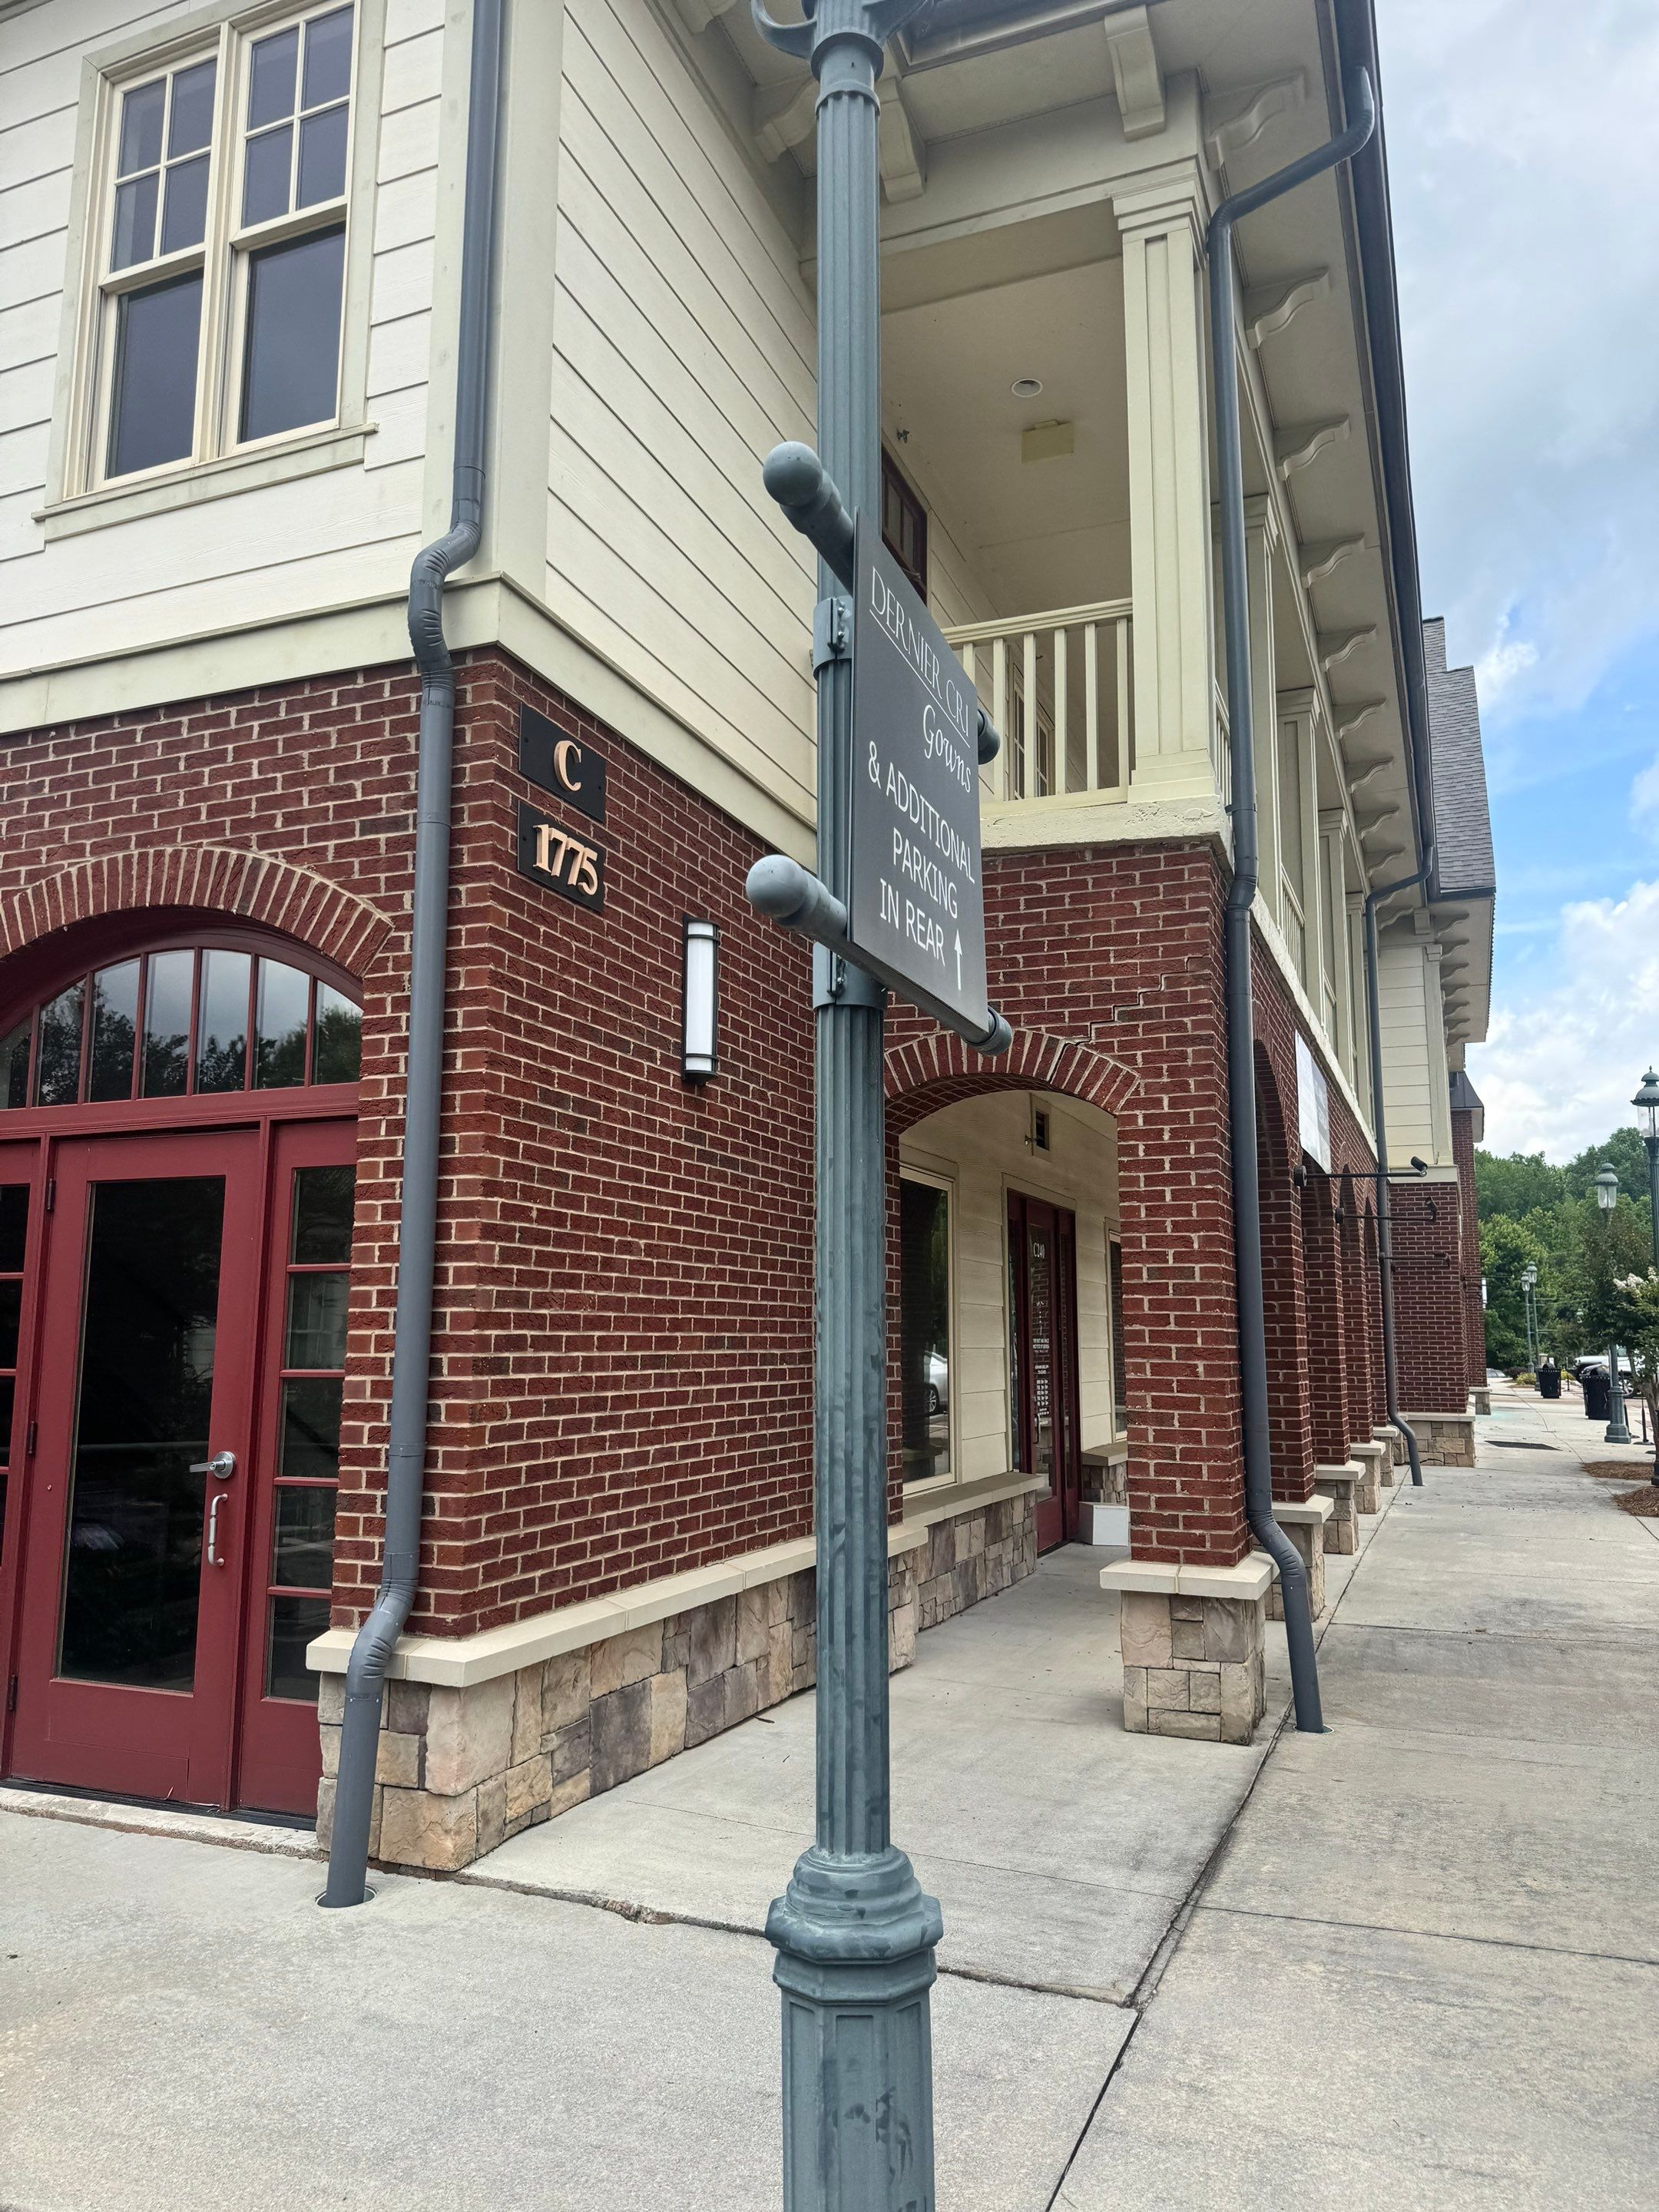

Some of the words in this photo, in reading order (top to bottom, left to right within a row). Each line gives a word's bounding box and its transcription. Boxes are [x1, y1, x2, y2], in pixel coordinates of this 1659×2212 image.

[872, 565, 943, 700] DERNIER
[946, 679, 969, 737] CRI
[554, 740, 582, 792] C
[922, 704, 972, 793] Gowns
[868, 740, 882, 790] &
[886, 762, 975, 885] ADDITIONAL
[532, 823, 598, 896] 1775
[892, 826, 959, 919] PARKING
[879, 877, 900, 930] IN
[906, 899, 945, 967] REAR
